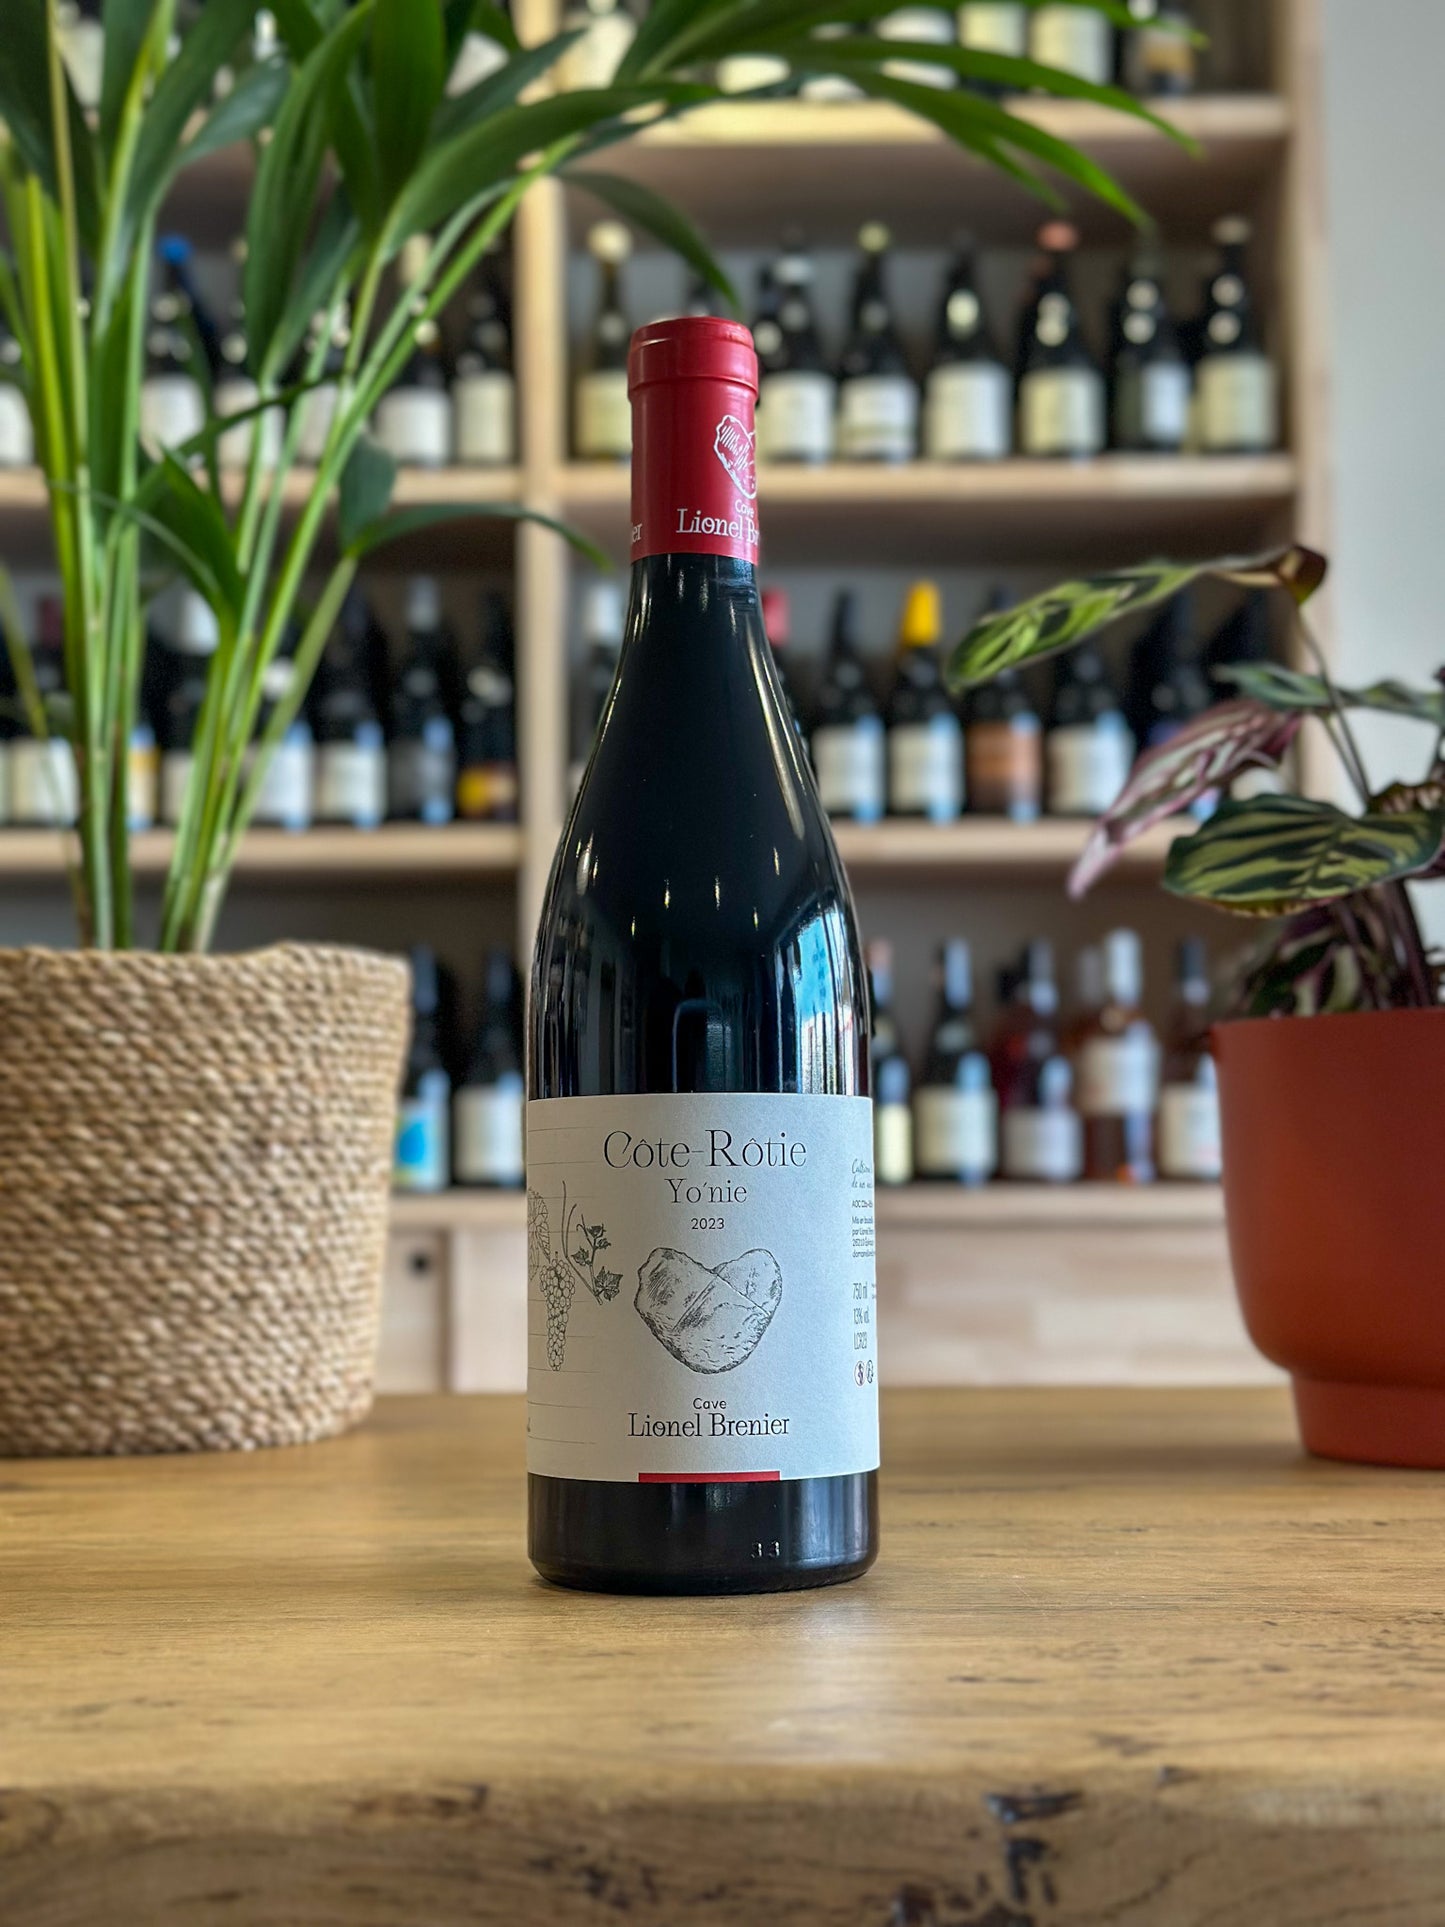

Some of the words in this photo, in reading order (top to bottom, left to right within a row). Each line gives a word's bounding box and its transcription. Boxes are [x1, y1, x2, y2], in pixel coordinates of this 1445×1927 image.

[676, 508, 744, 540] Lionel
[603, 1129, 807, 1169] Côte-Rôtie
[690, 1217, 725, 1230] 2023
[692, 1397, 727, 1410] Cave
[627, 1412, 702, 1437] Lionel
[707, 1412, 790, 1437] Brenier
